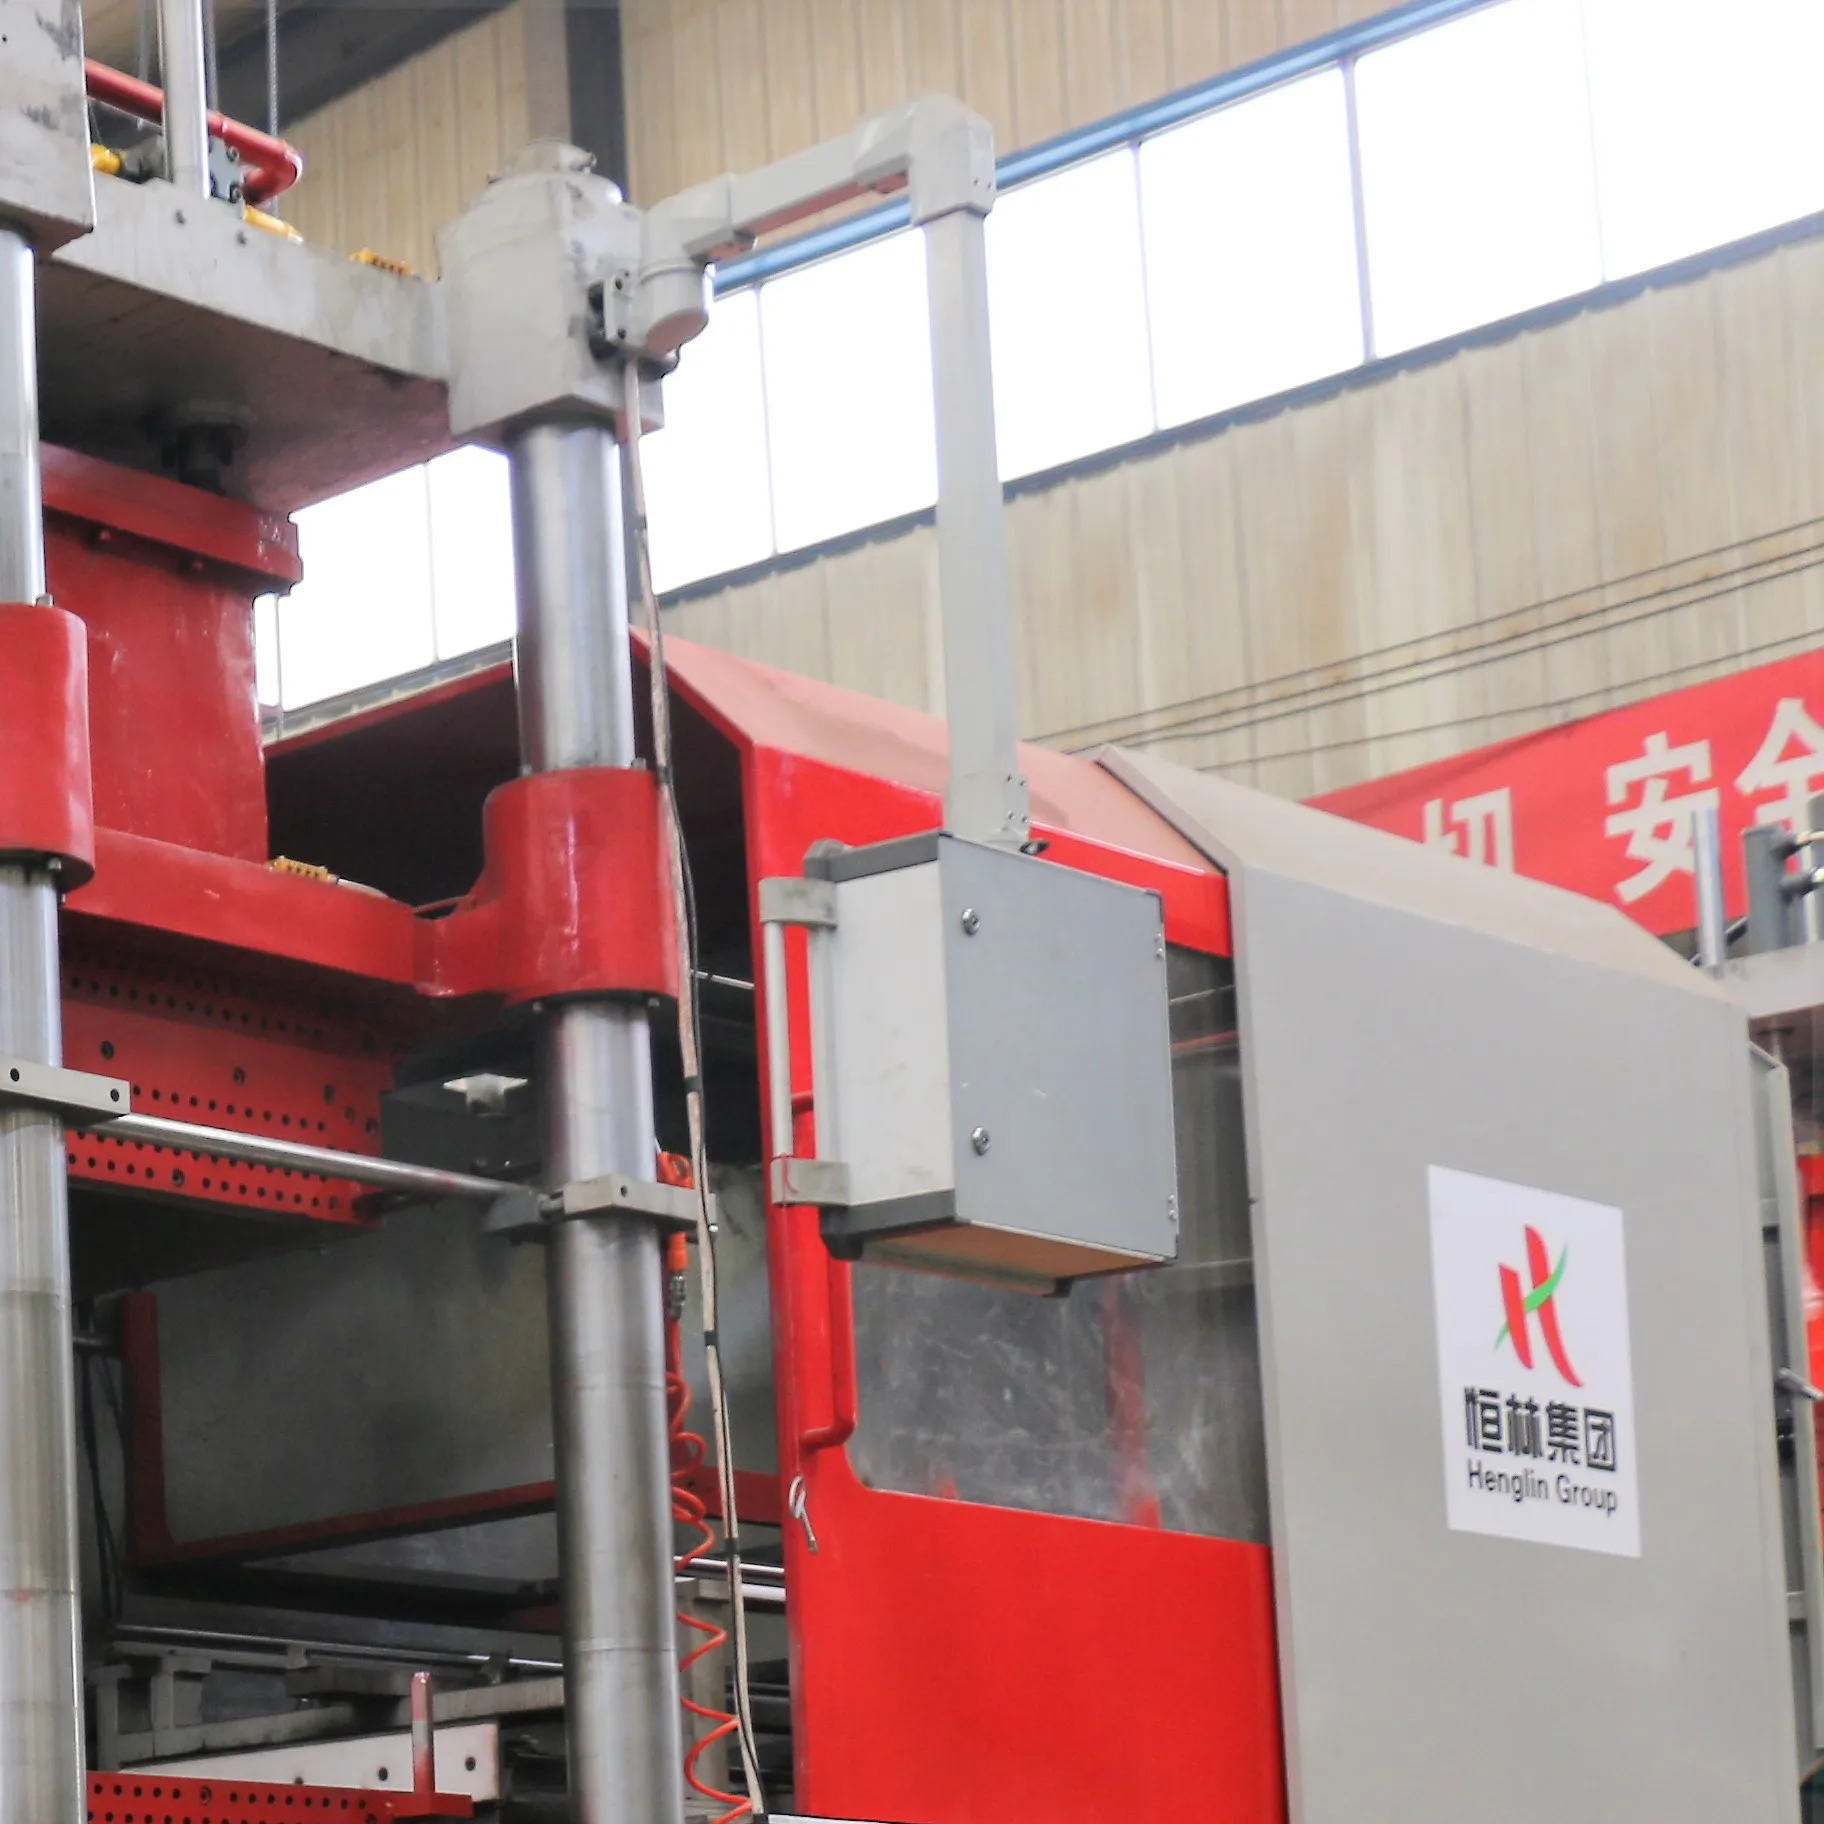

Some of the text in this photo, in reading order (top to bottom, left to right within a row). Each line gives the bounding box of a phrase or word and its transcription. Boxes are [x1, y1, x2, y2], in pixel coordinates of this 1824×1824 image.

[1464, 1386, 1616, 1472] 恒林集团
[1467, 1457, 1618, 1518] Henglin Group
